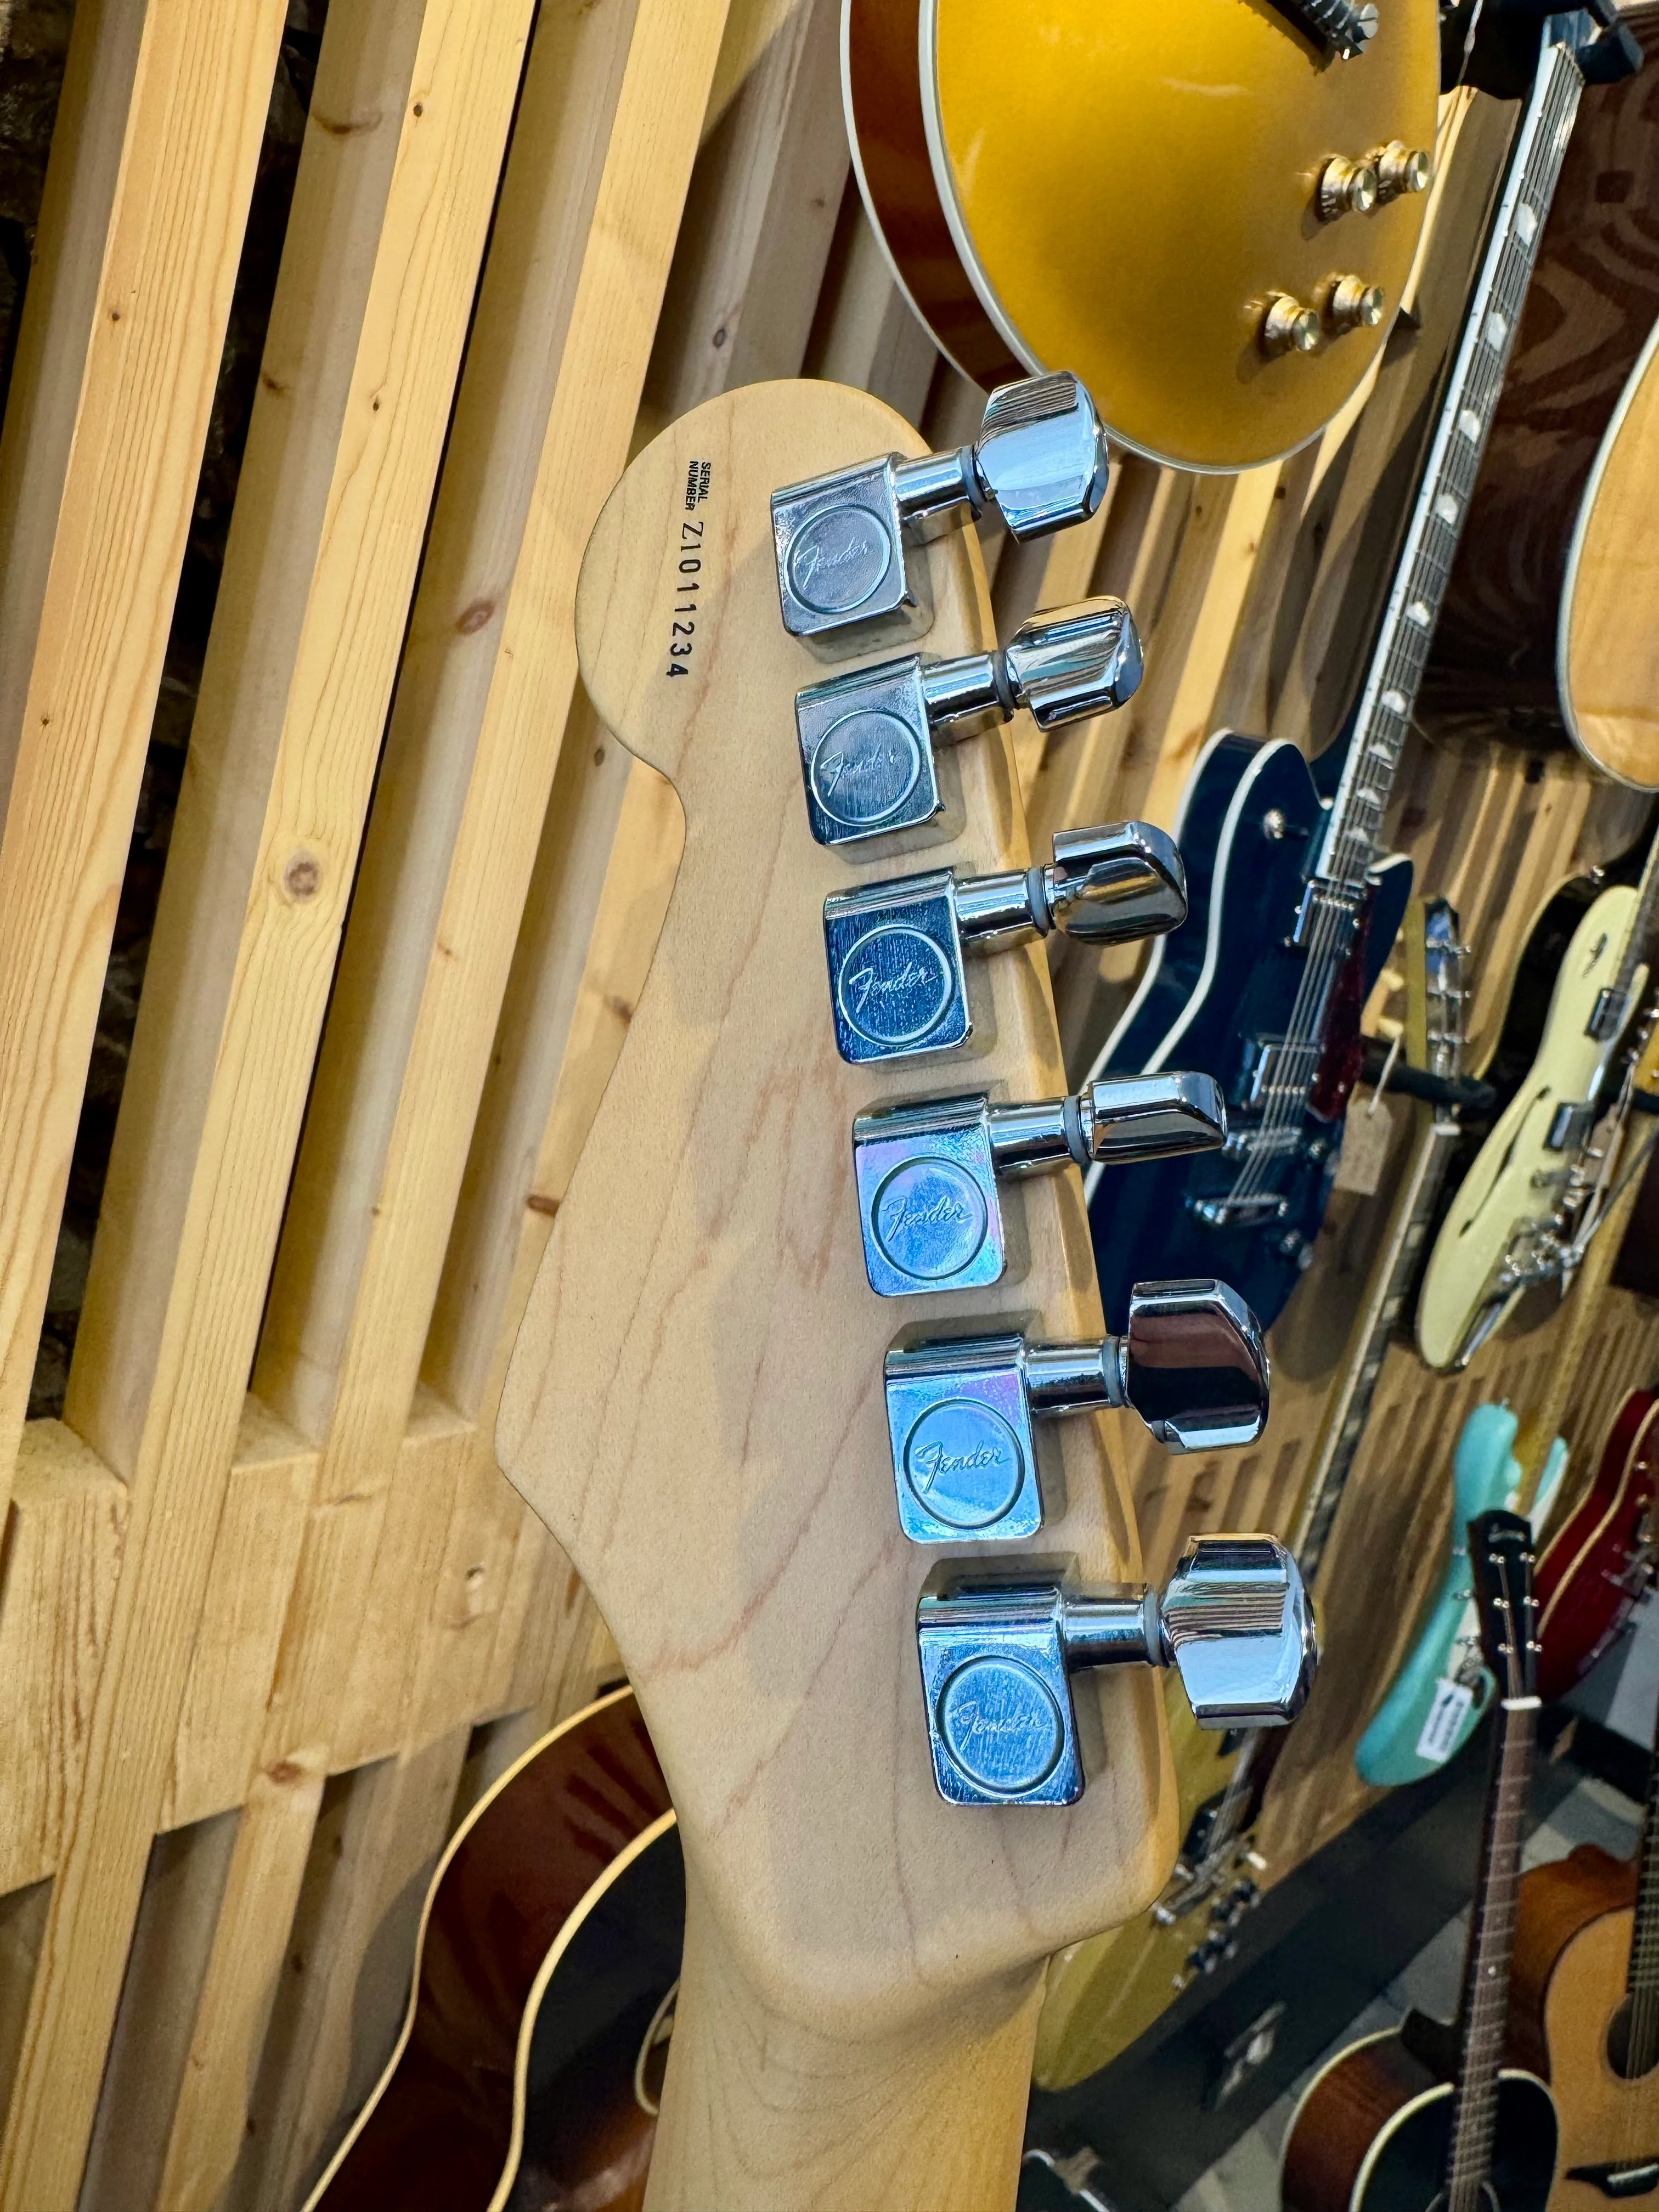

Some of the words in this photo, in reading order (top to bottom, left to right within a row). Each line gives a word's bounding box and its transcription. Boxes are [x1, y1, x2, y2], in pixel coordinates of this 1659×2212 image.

[685, 460, 699, 511] NUMBER
[697, 461, 711, 503] SERIAL
[795, 537, 874, 589] Fender
[666, 521, 704, 678] Z10111234
[849, 961, 938, 1014] Fender
[881, 1194, 973, 1242] Fender
[915, 1440, 1011, 1494] Fender
[955, 1700, 1052, 1752] Fender
